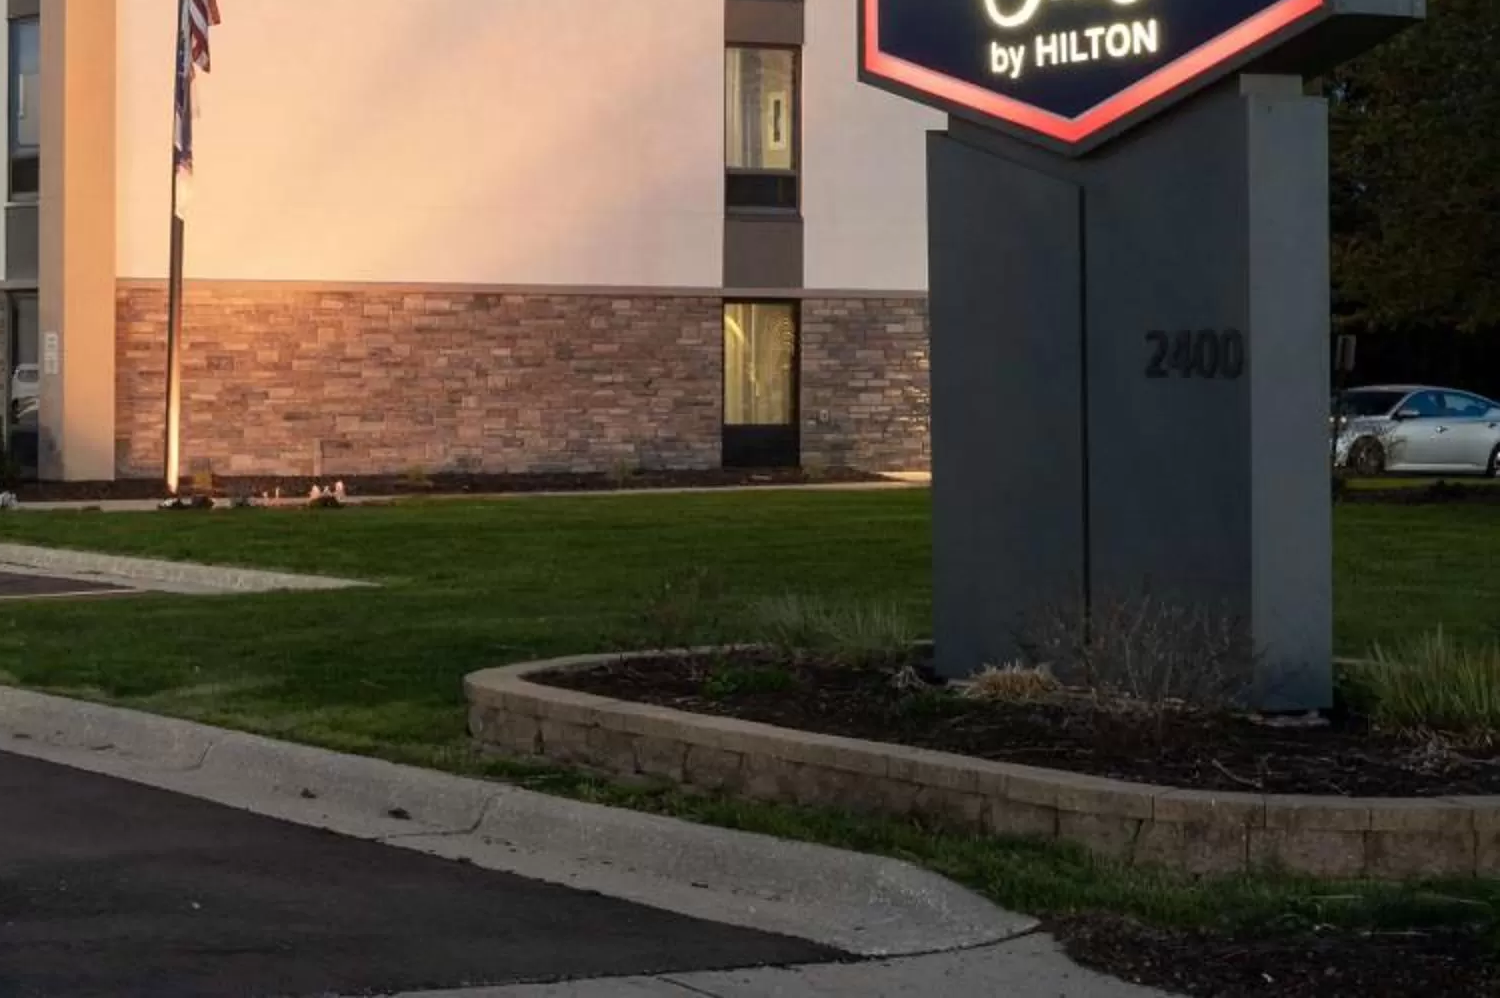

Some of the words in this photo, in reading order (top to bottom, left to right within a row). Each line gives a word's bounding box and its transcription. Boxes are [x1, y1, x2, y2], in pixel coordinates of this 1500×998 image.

[991, 41, 1025, 79] by
[1035, 18, 1159, 67] HILTON
[1144, 327, 1244, 379] 2400
